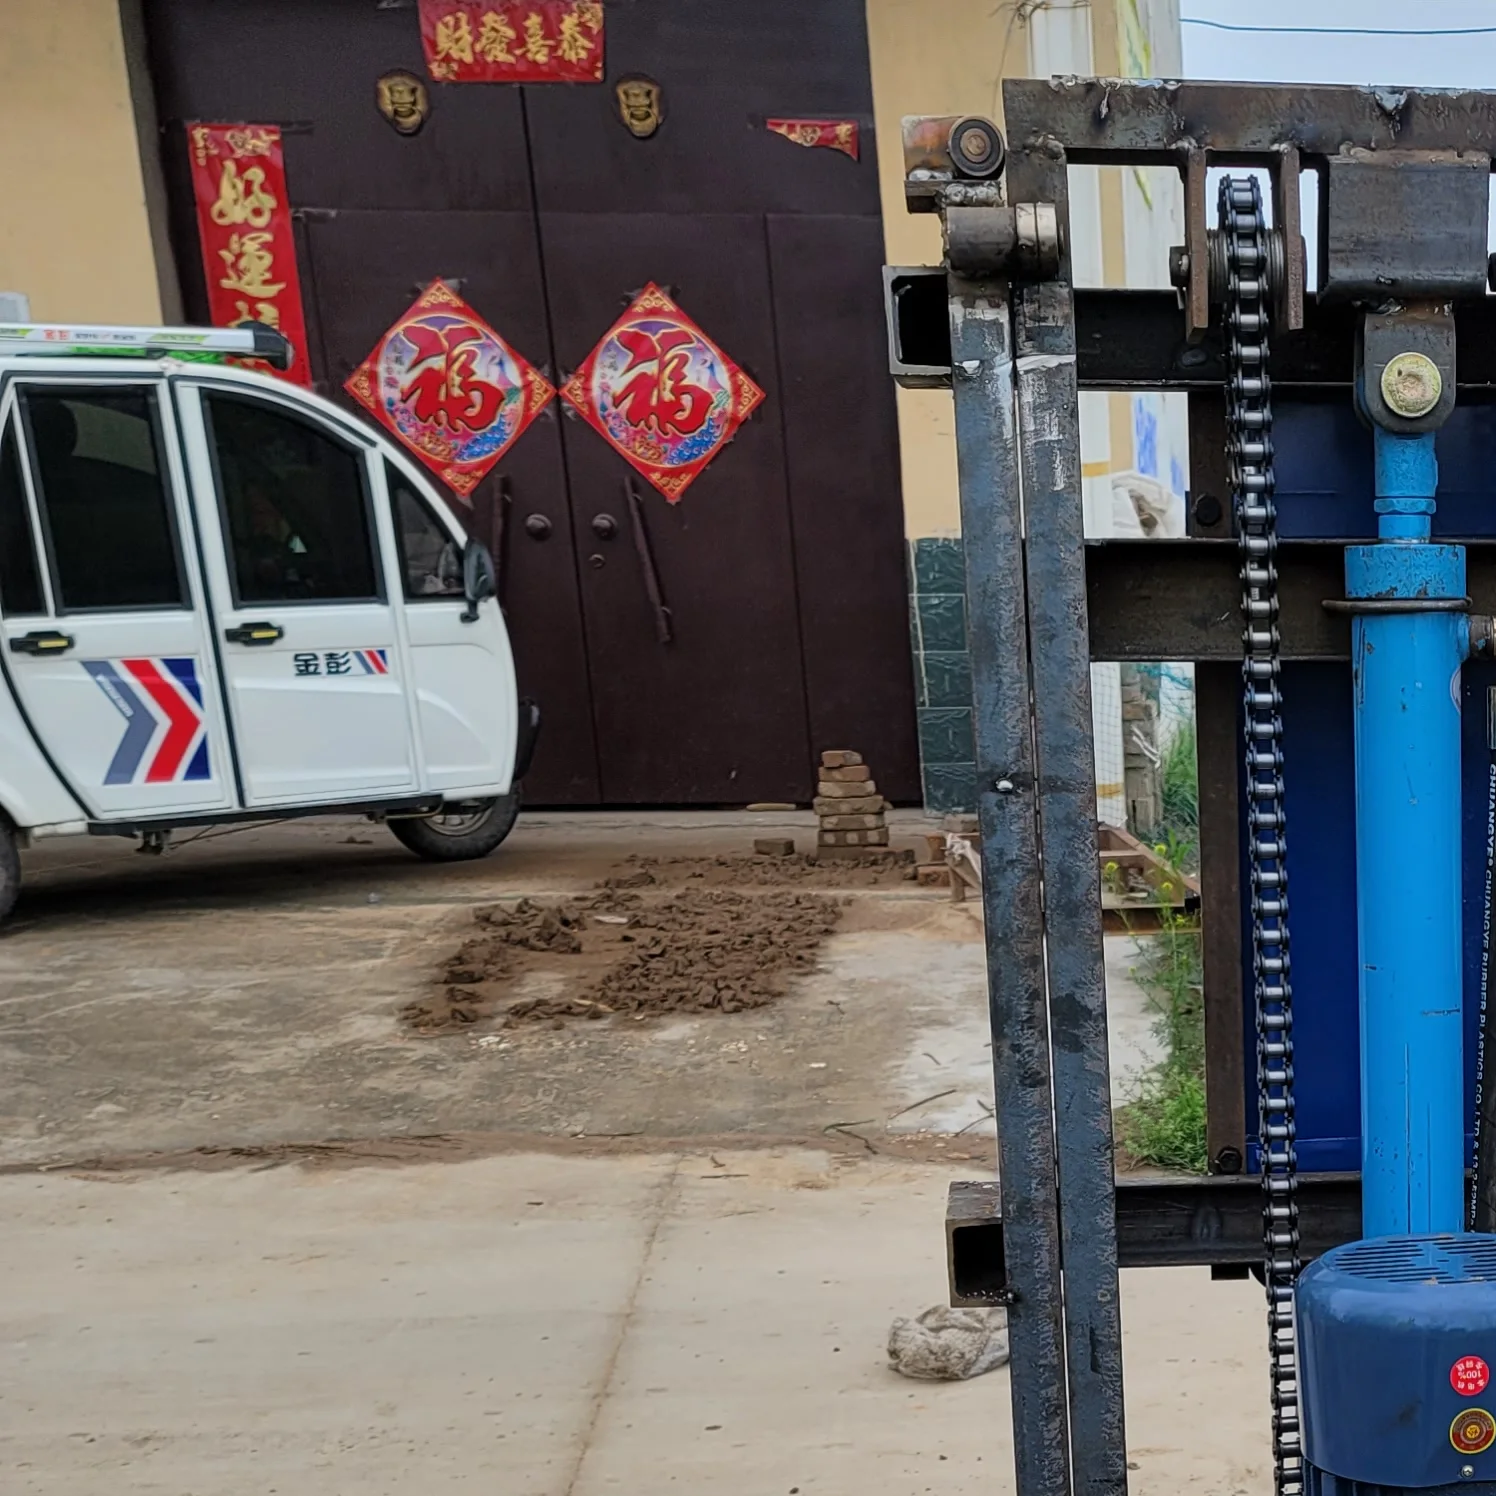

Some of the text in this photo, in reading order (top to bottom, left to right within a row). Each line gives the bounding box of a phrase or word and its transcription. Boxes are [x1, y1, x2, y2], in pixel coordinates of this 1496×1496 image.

[400, 323, 505, 431] 福
[612, 328, 717, 436] 福
[294, 652, 352, 677] 金彭
[1457, 1371, 1482, 1379] 100%
